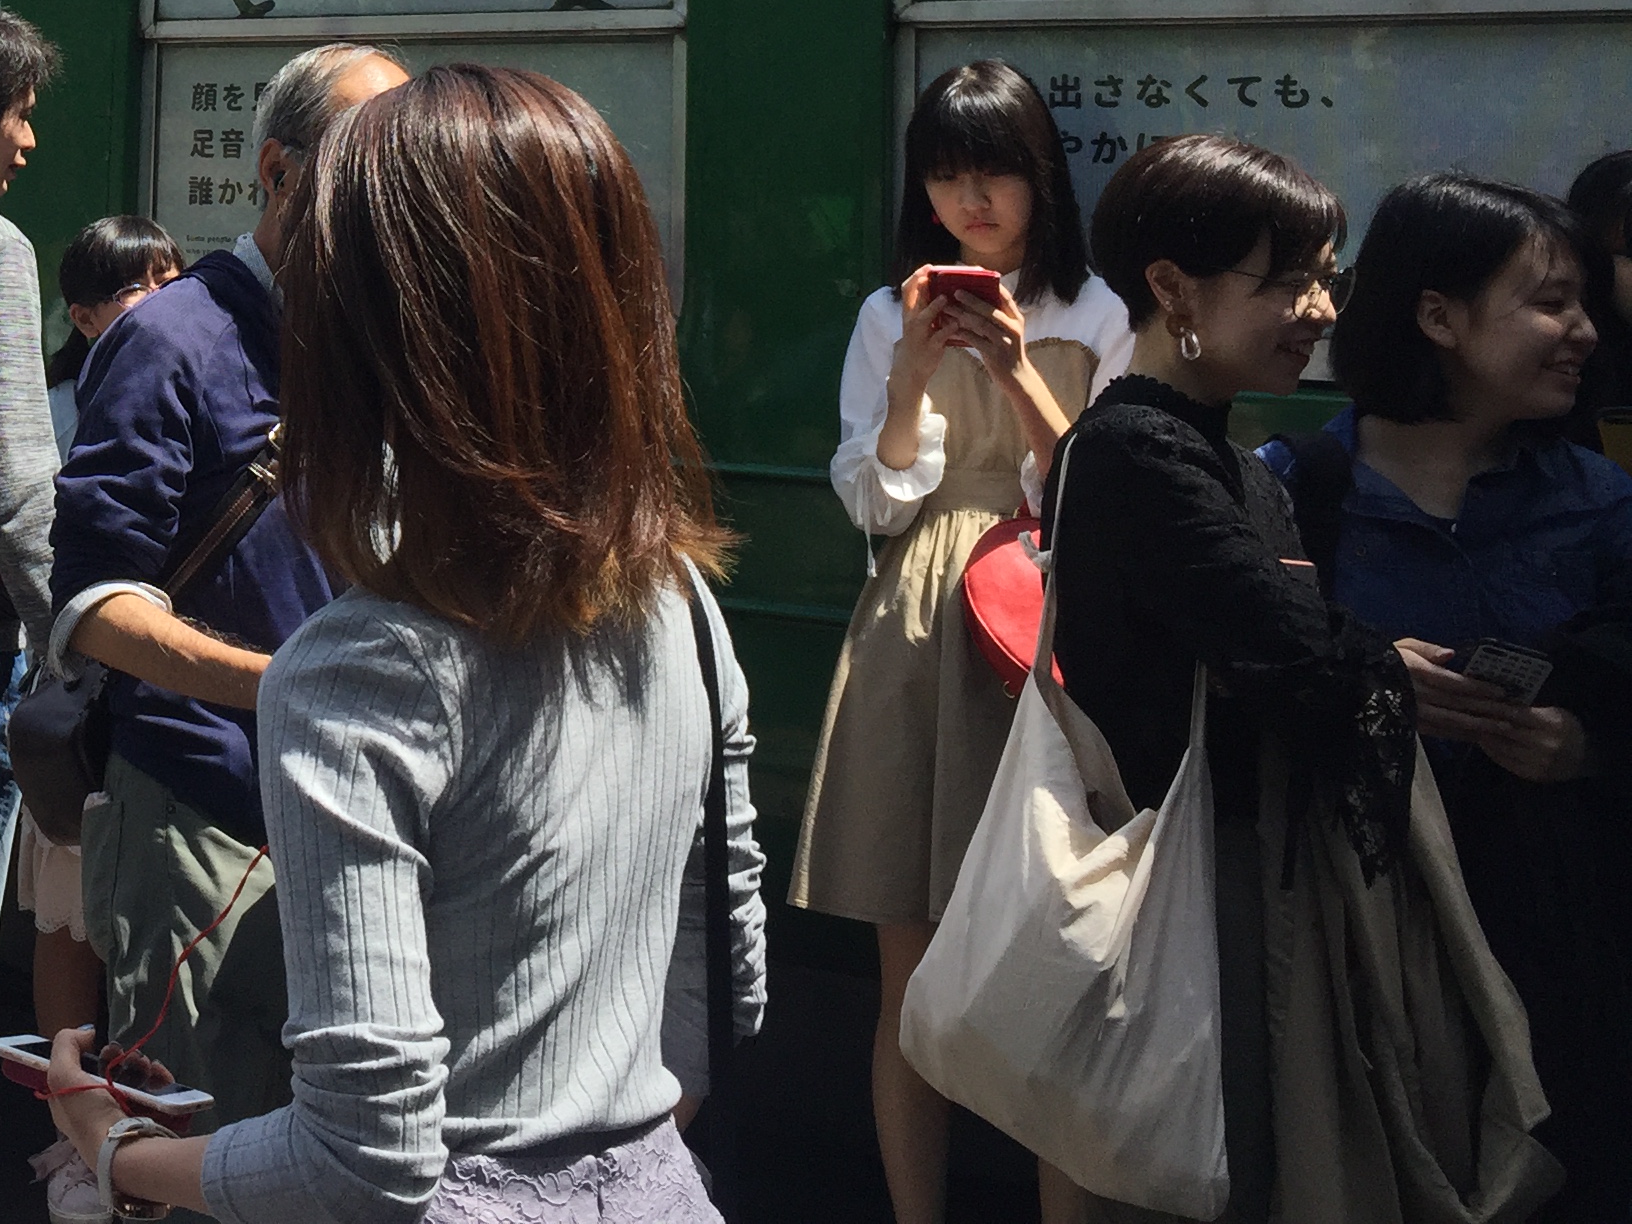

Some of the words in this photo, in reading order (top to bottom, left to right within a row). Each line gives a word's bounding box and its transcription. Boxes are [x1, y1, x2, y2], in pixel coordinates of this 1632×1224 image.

[1049, 74, 1333, 109] 出さなくても、
